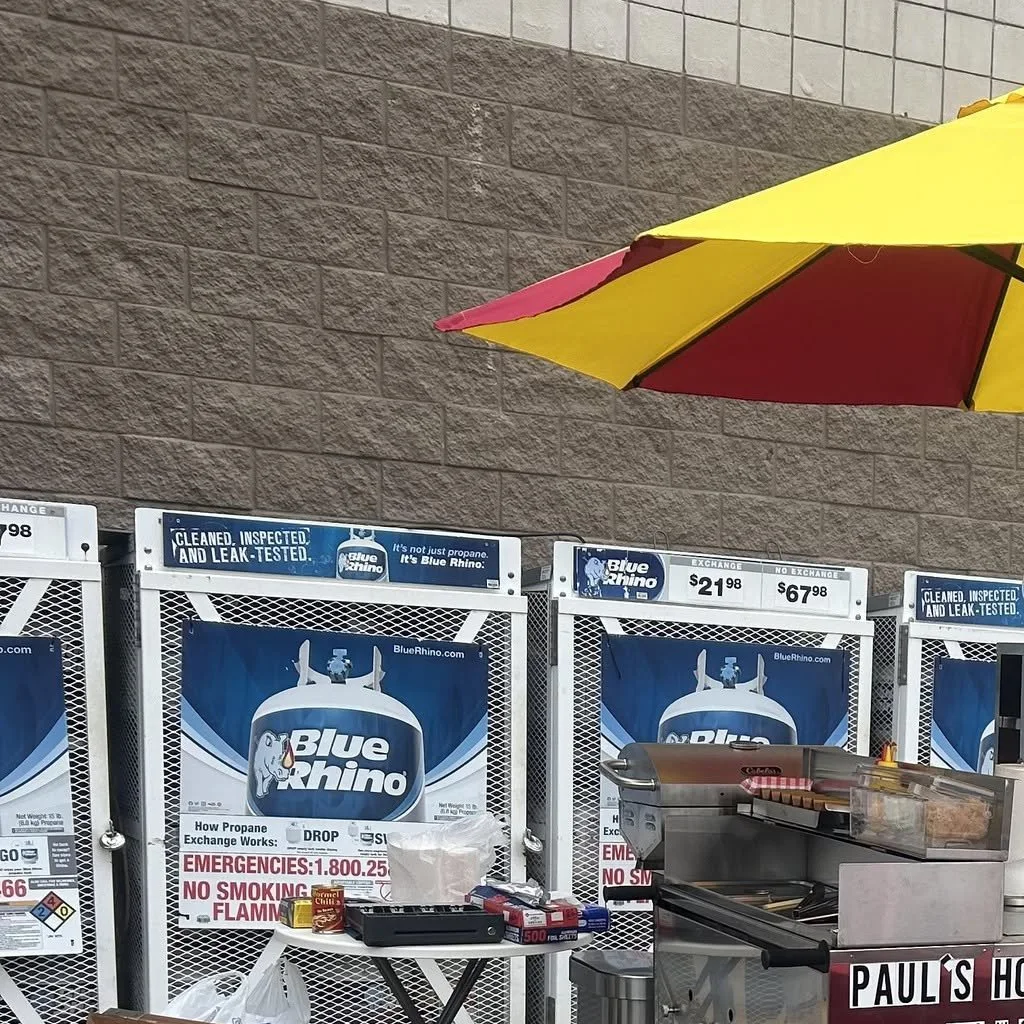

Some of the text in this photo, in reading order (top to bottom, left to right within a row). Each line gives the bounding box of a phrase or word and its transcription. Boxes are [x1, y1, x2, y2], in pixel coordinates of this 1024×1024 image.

[179, 546, 312, 563] AND LEAK-TESTED.
[348, 552, 378, 562] Blue
[392, 543, 489, 560] It's not just propane.
[400, 553, 417, 564] It's
[421, 556, 445, 567] Blue
[608, 558, 649, 574] Blue
[691, 559, 742, 571] EXCHANGE
[775, 567, 839, 579] NO EXCHANGE
[603, 572, 657, 589] Rhino
[926, 602, 1020, 617] AND LEAK-TESTED.
[393, 644, 466, 659] BlueRhino.com
[773, 652, 831, 664] BlueRhino.com
[289, 729, 389, 761] Blue
[277, 760, 408, 797] Rhino
[195, 821, 268, 835] How Propane
[184, 835, 278, 848] Exchange Works:
[303, 829, 340, 843] DROP
[602, 868, 625, 885] NO
[183, 880, 307, 901] NO SMOKING
[37, 907, 45, 917] 2
[524, 929, 546, 943] 500
